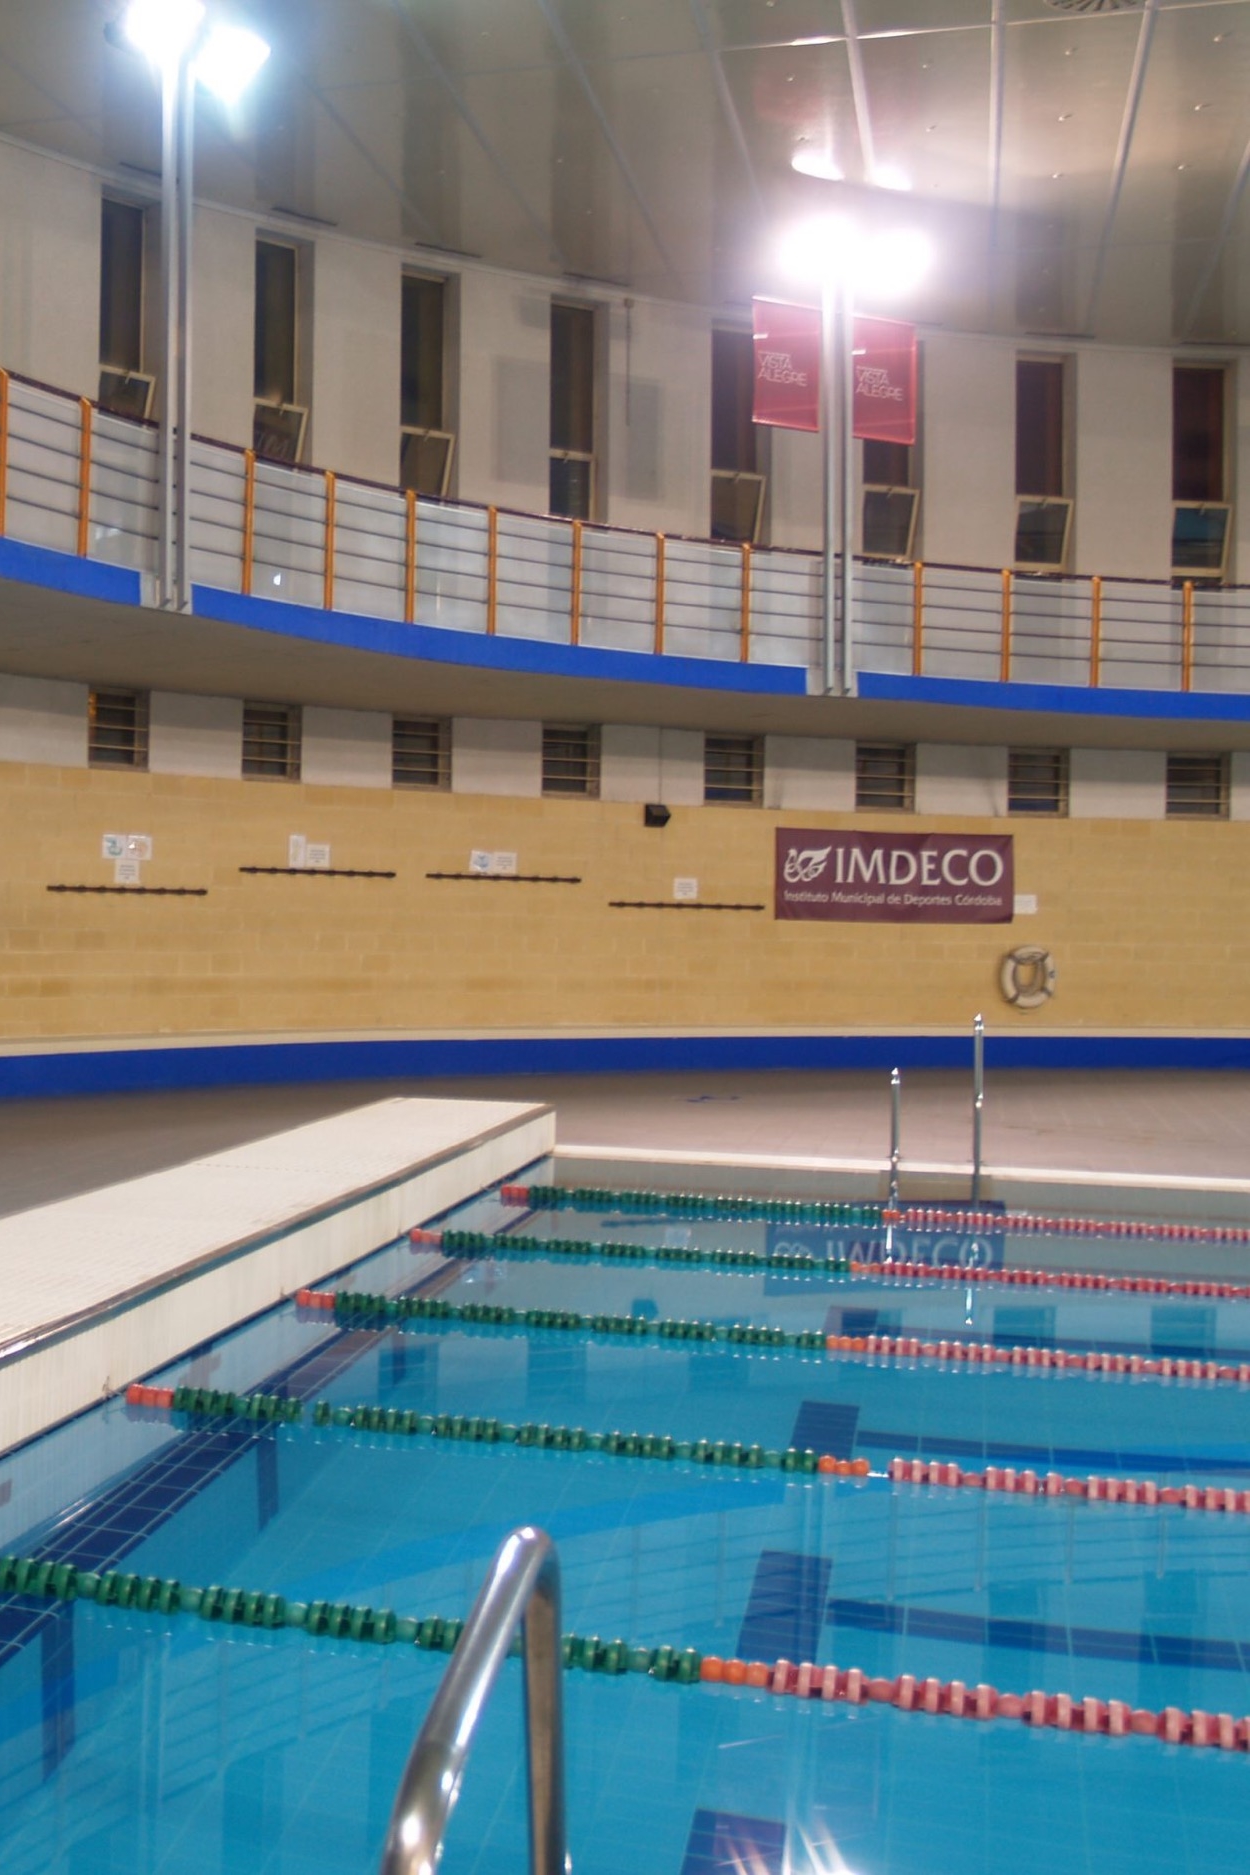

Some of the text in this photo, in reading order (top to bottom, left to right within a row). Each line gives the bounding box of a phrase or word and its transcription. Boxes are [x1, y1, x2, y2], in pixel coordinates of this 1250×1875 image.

[759, 355, 792, 369] VISTA
[757, 368, 808, 387] ALEGRE
[857, 370, 889, 385] VISTA
[855, 384, 903, 401] ALEGRE
[834, 847, 1004, 887] IMDECO
[784, 890, 829, 904] Instituto
[831, 891, 884, 907] Municipal
[887, 893, 901, 905] de
[903, 894, 952, 908] Deportes
[955, 893, 1002, 906] Córdoba
